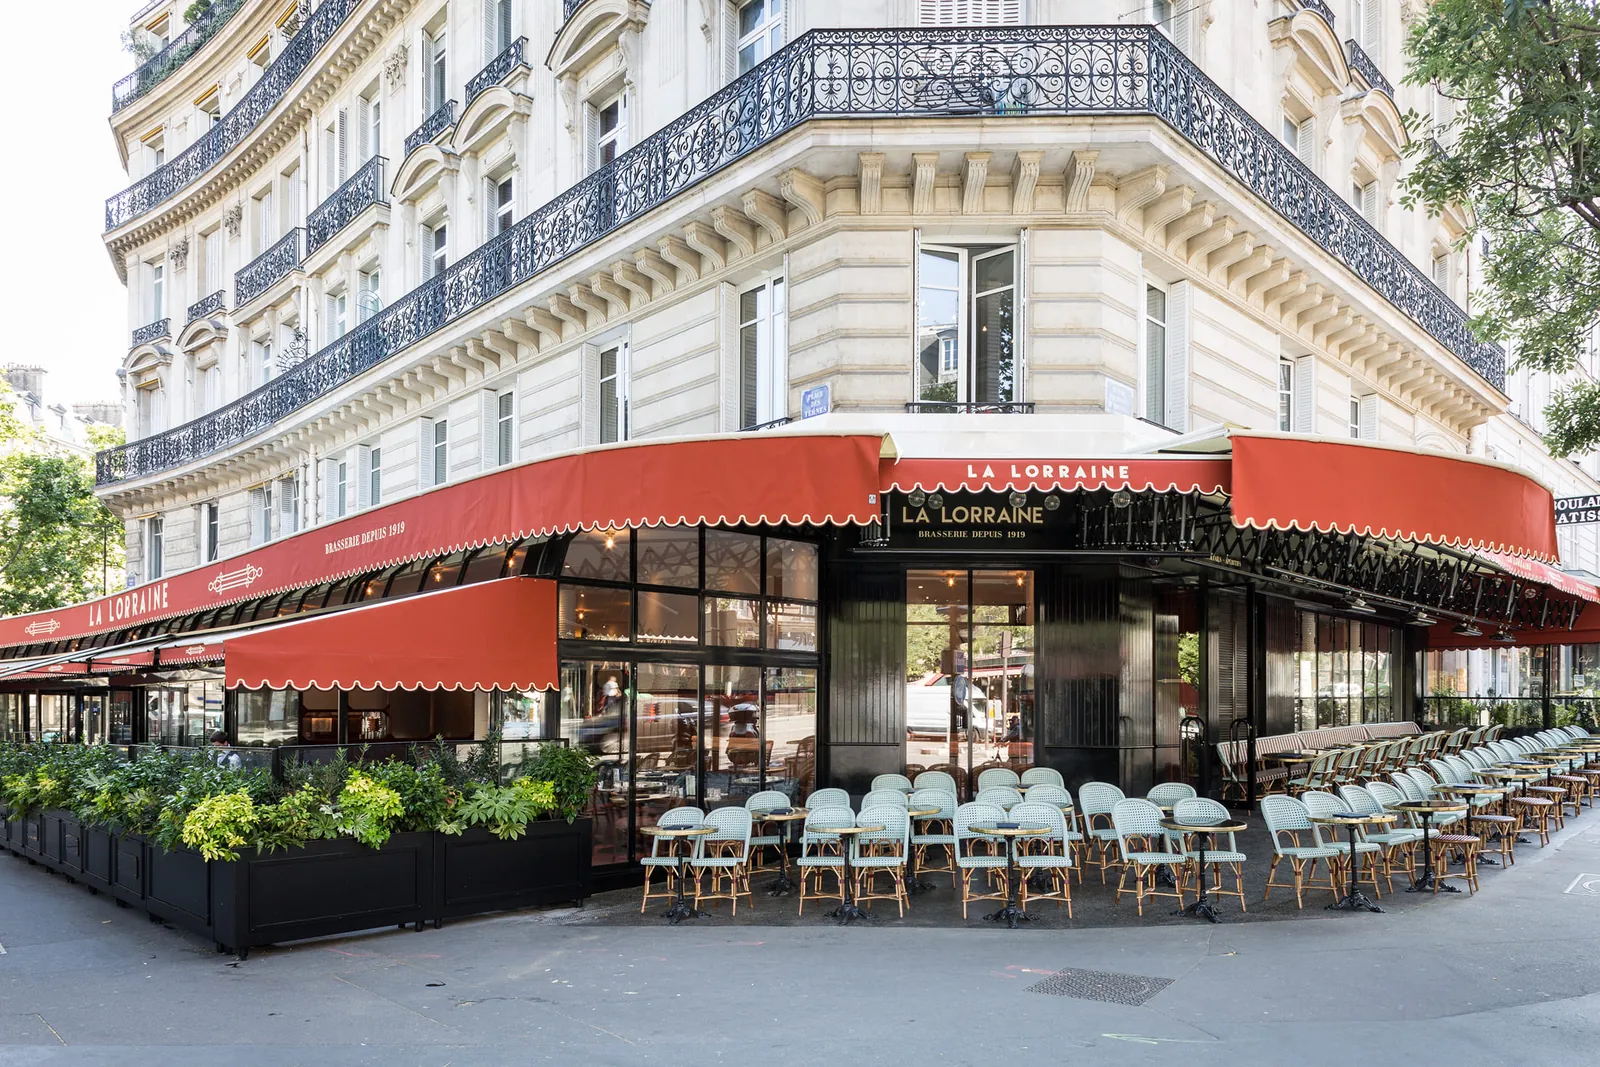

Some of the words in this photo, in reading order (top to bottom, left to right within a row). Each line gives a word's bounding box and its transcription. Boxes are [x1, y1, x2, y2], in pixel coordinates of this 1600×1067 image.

[806, 390, 824, 403] PLACE
[804, 406, 827, 417] TERNES
[967, 464, 995, 478] LA
[1011, 465, 1129, 479] LORRAINE
[902, 506, 930, 523] LA
[941, 506, 1044, 524] LORRAINE
[325, 534, 360, 555] BRASSERIE
[361, 526, 387, 545] DEPUIS
[388, 520, 405, 537] 1919
[918, 530, 969, 538] BRASSERIE
[972, 530, 1003, 538] DEPUIS
[1007, 530, 1026, 539] 1919
[89, 604, 102, 627] LA
[109, 582, 169, 622] LORRAINE
